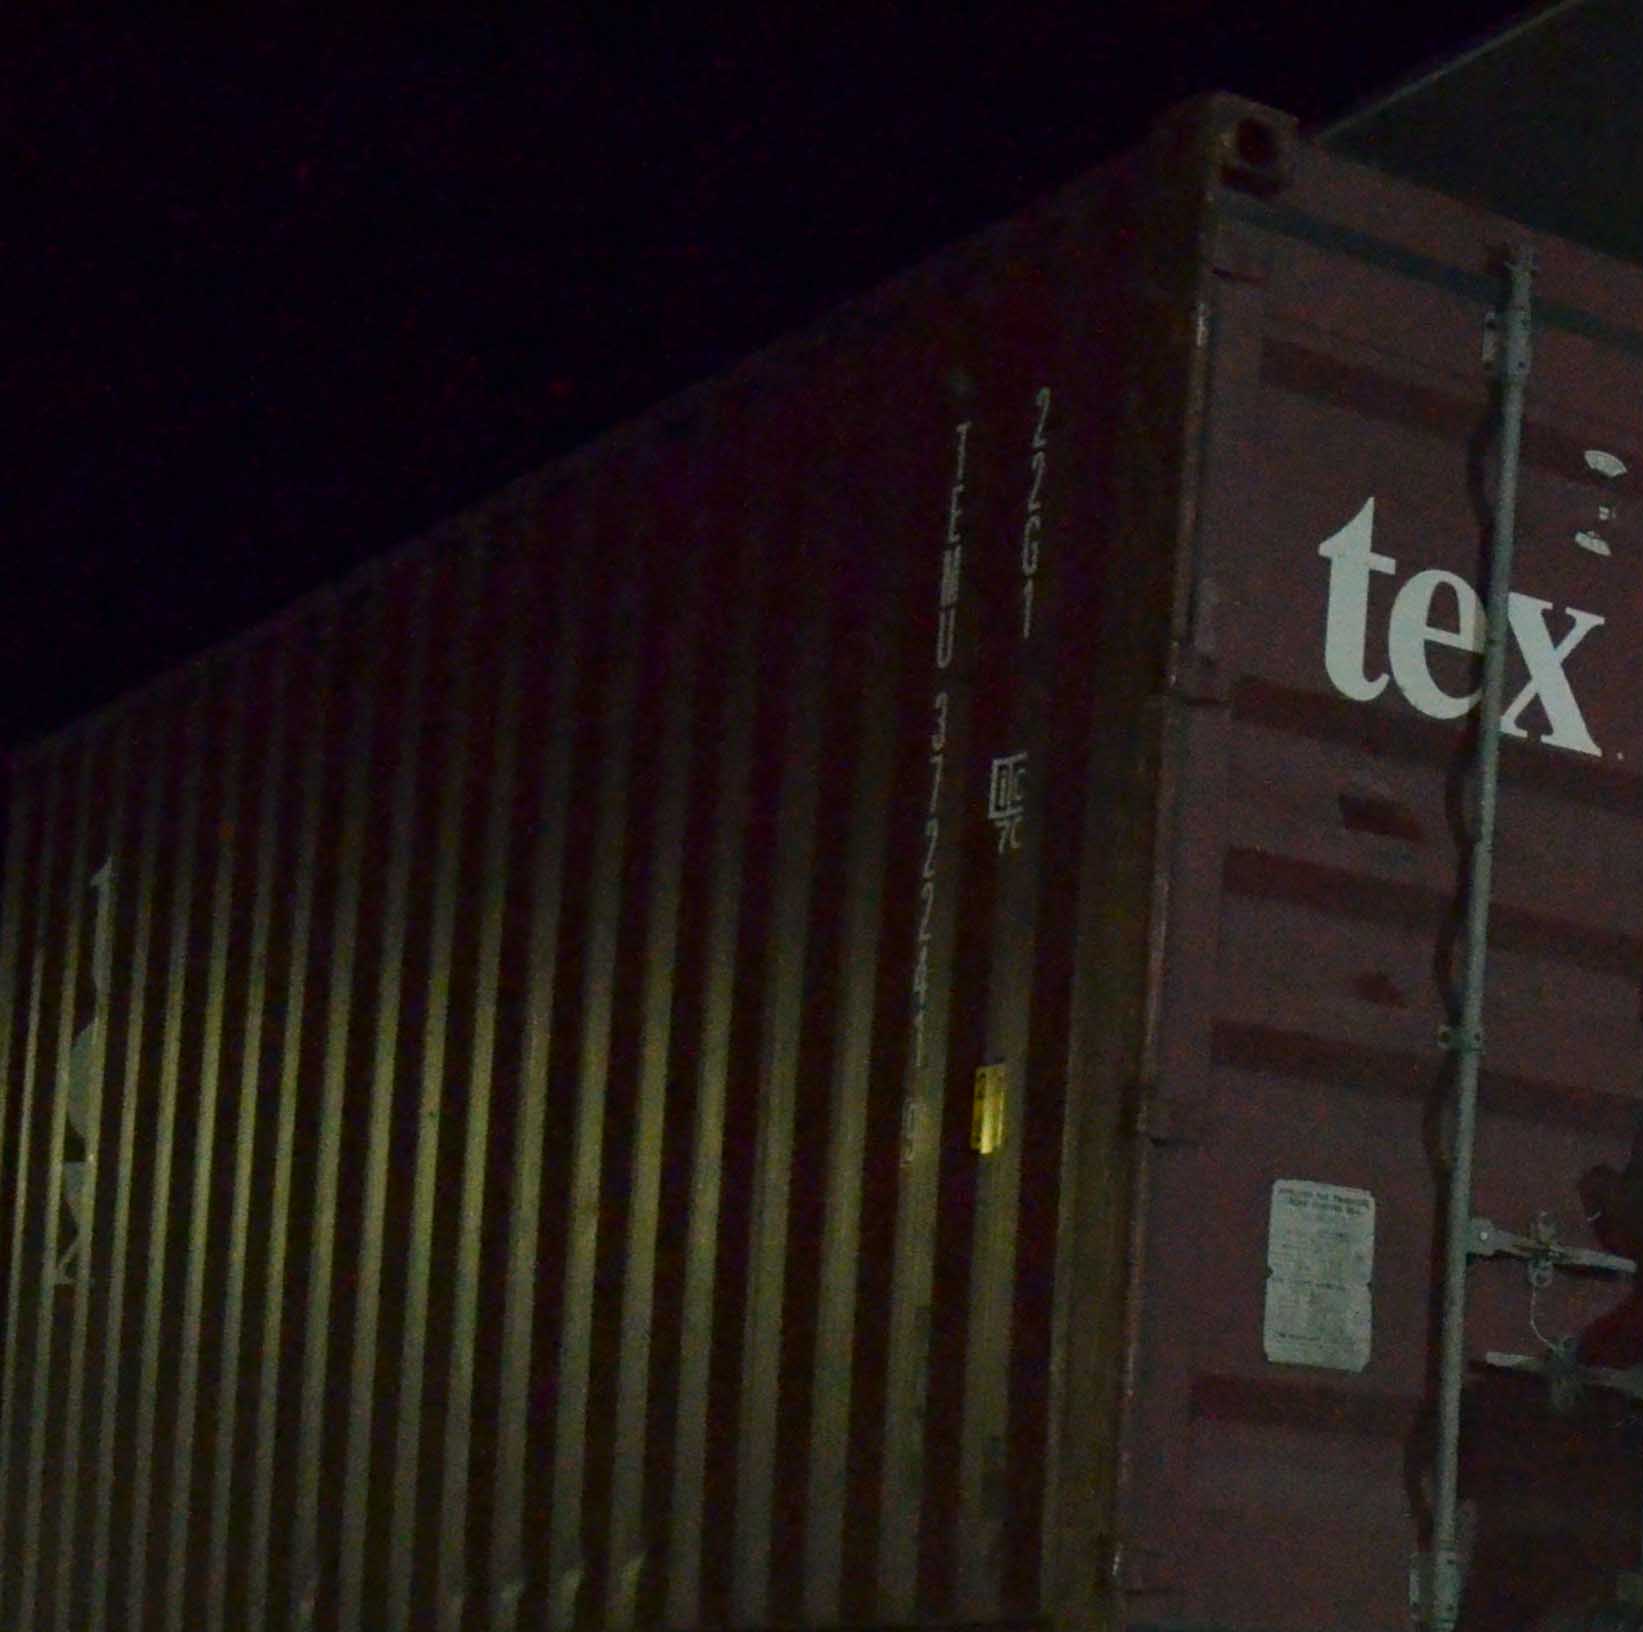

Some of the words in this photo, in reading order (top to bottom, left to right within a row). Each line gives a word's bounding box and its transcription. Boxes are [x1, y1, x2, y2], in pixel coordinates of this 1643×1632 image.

[936, 420, 973, 669] TEMU
[1021, 386, 1052, 640] 22G1
[1318, 497, 1606, 759] tex
